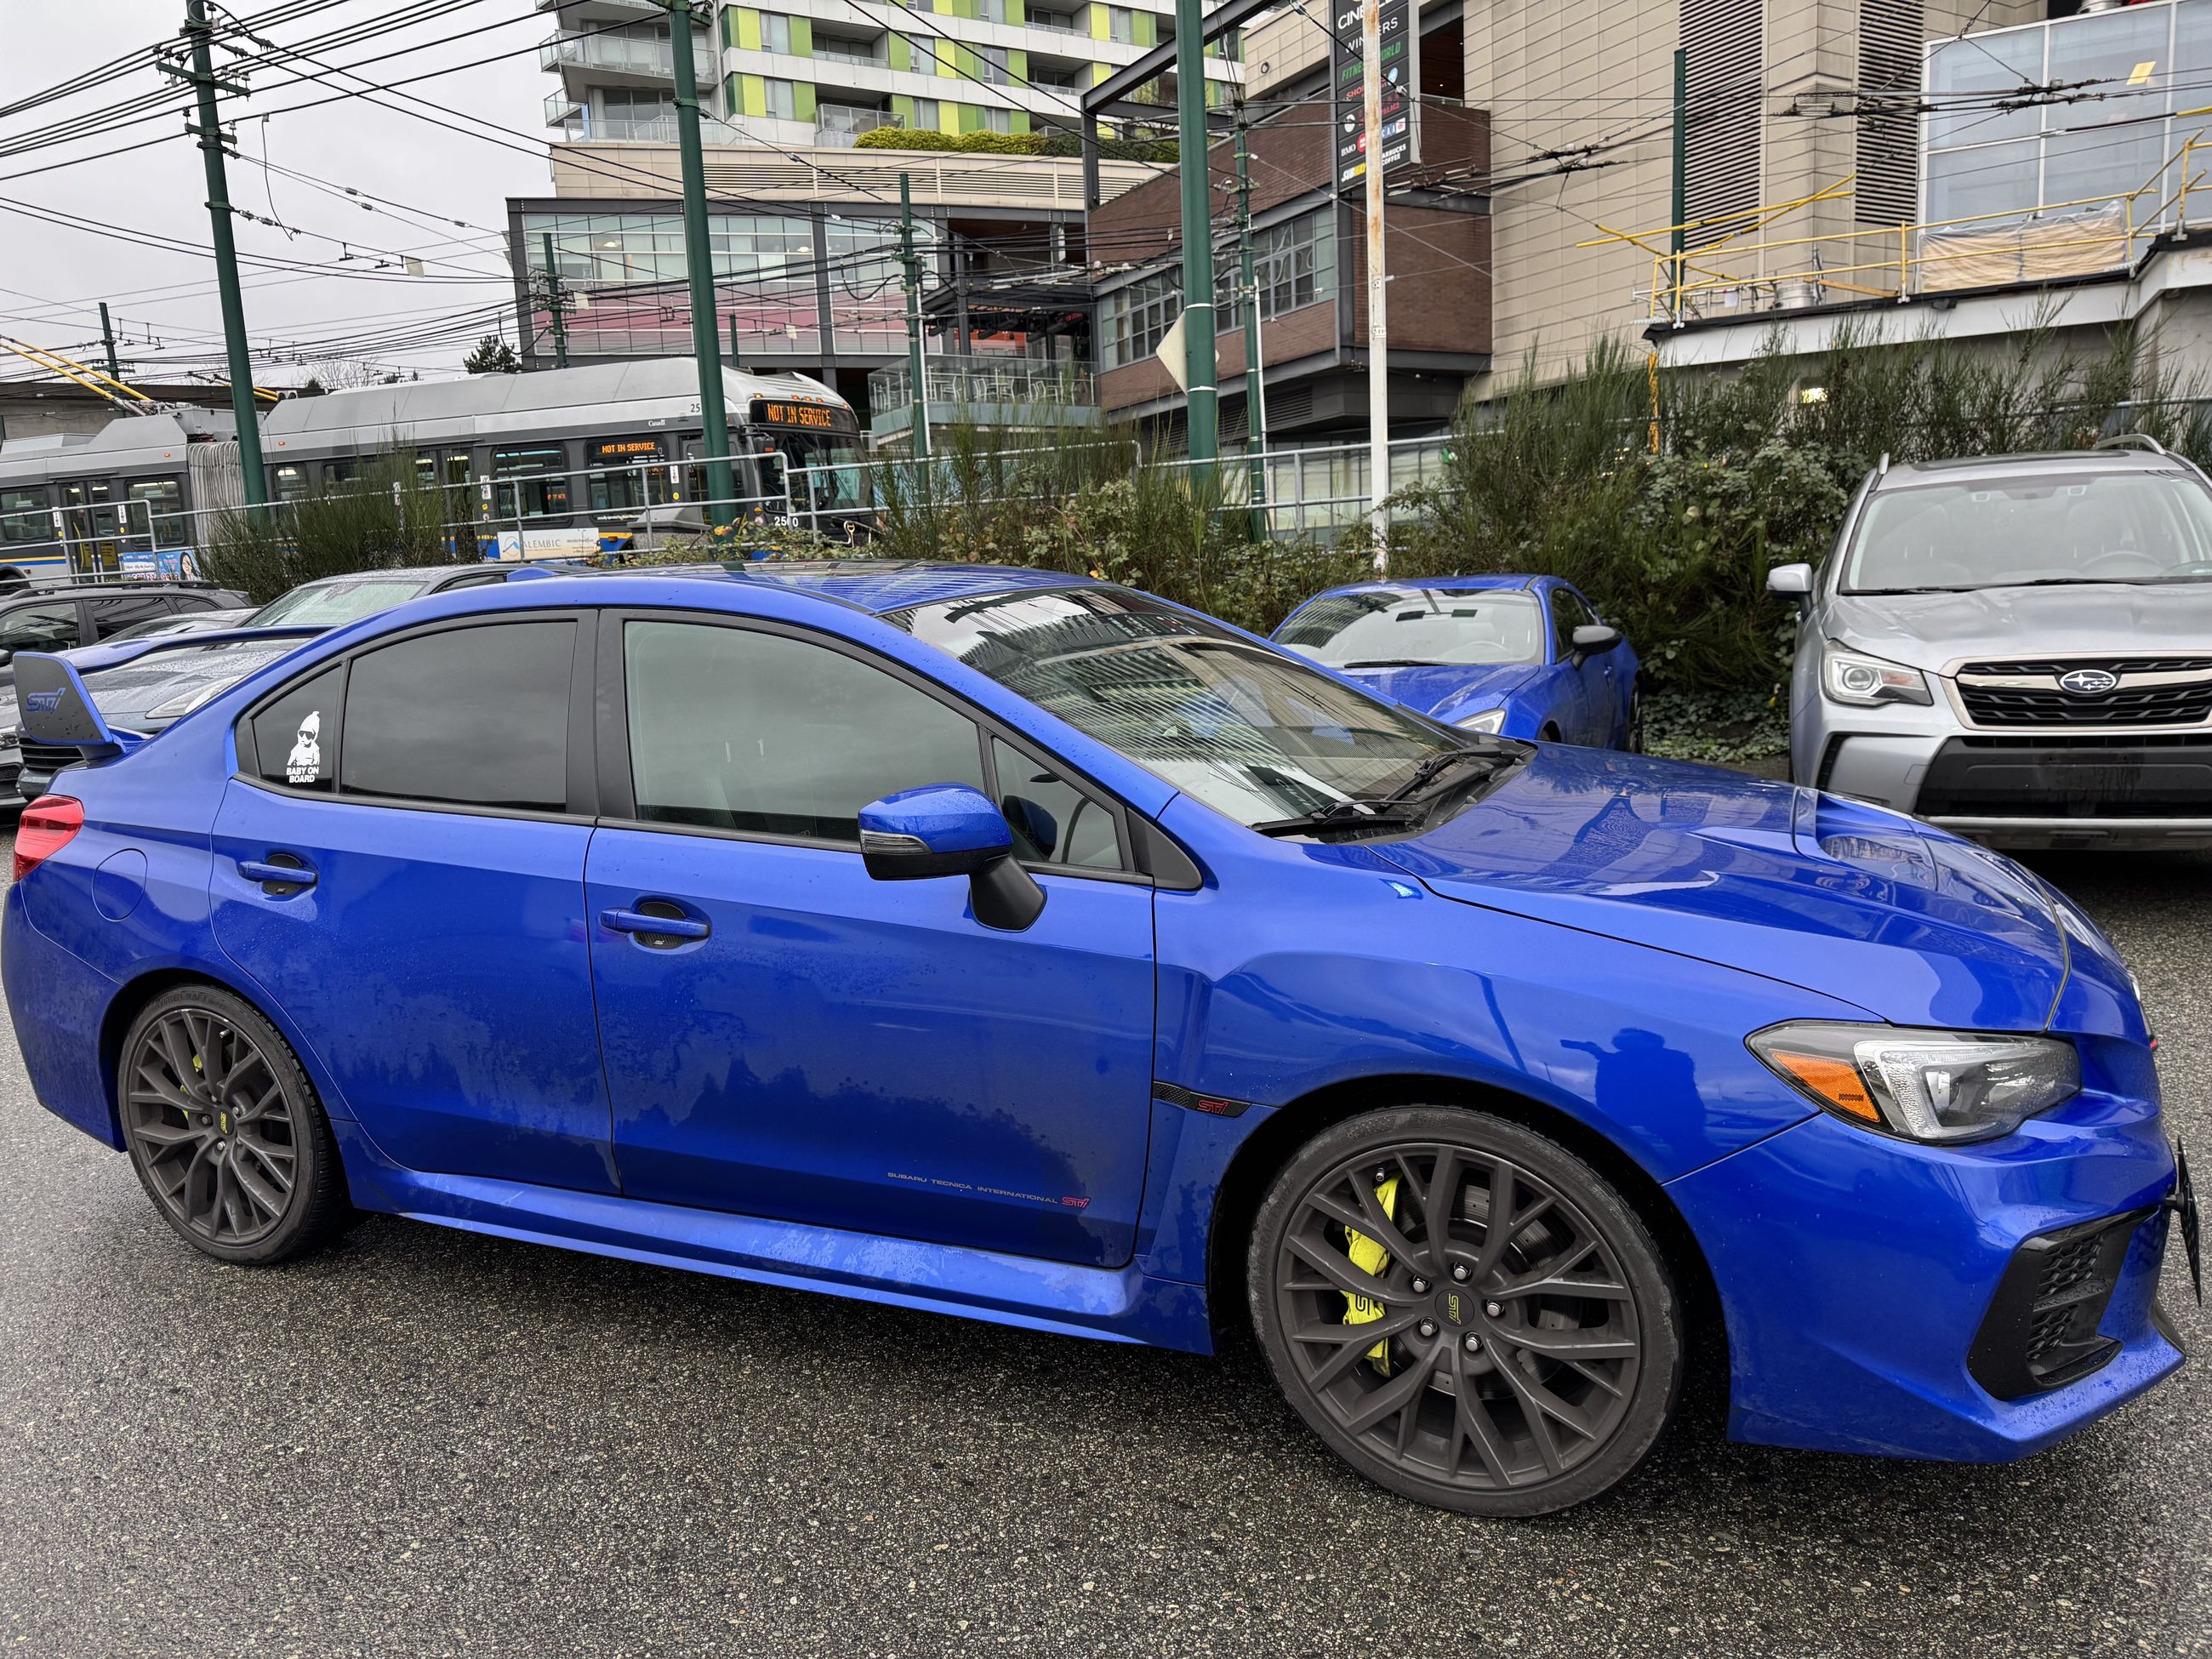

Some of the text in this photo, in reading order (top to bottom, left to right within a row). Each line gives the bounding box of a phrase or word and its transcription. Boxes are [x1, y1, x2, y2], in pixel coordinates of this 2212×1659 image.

[1345, 17, 1399, 54] WINRS
[1380, 41, 1401, 61] ORLD
[1341, 144, 1356, 157] BMO
[1382, 143, 1406, 159] ARBUCKS
[1341, 162, 1366, 182] SUBWA
[767, 403, 831, 426] NOT IN SERVICE
[602, 442, 656, 453] NOT IN SERVICE
[774, 516, 799, 527] 250
[286, 766, 320, 775] BABY ON
[288, 774, 316, 784] BOARD
[887, 1172, 927, 1183] SUBARU
[931, 1178, 972, 1190] TECNICA
[977, 1186, 1058, 1204] INTERNATIONAL
